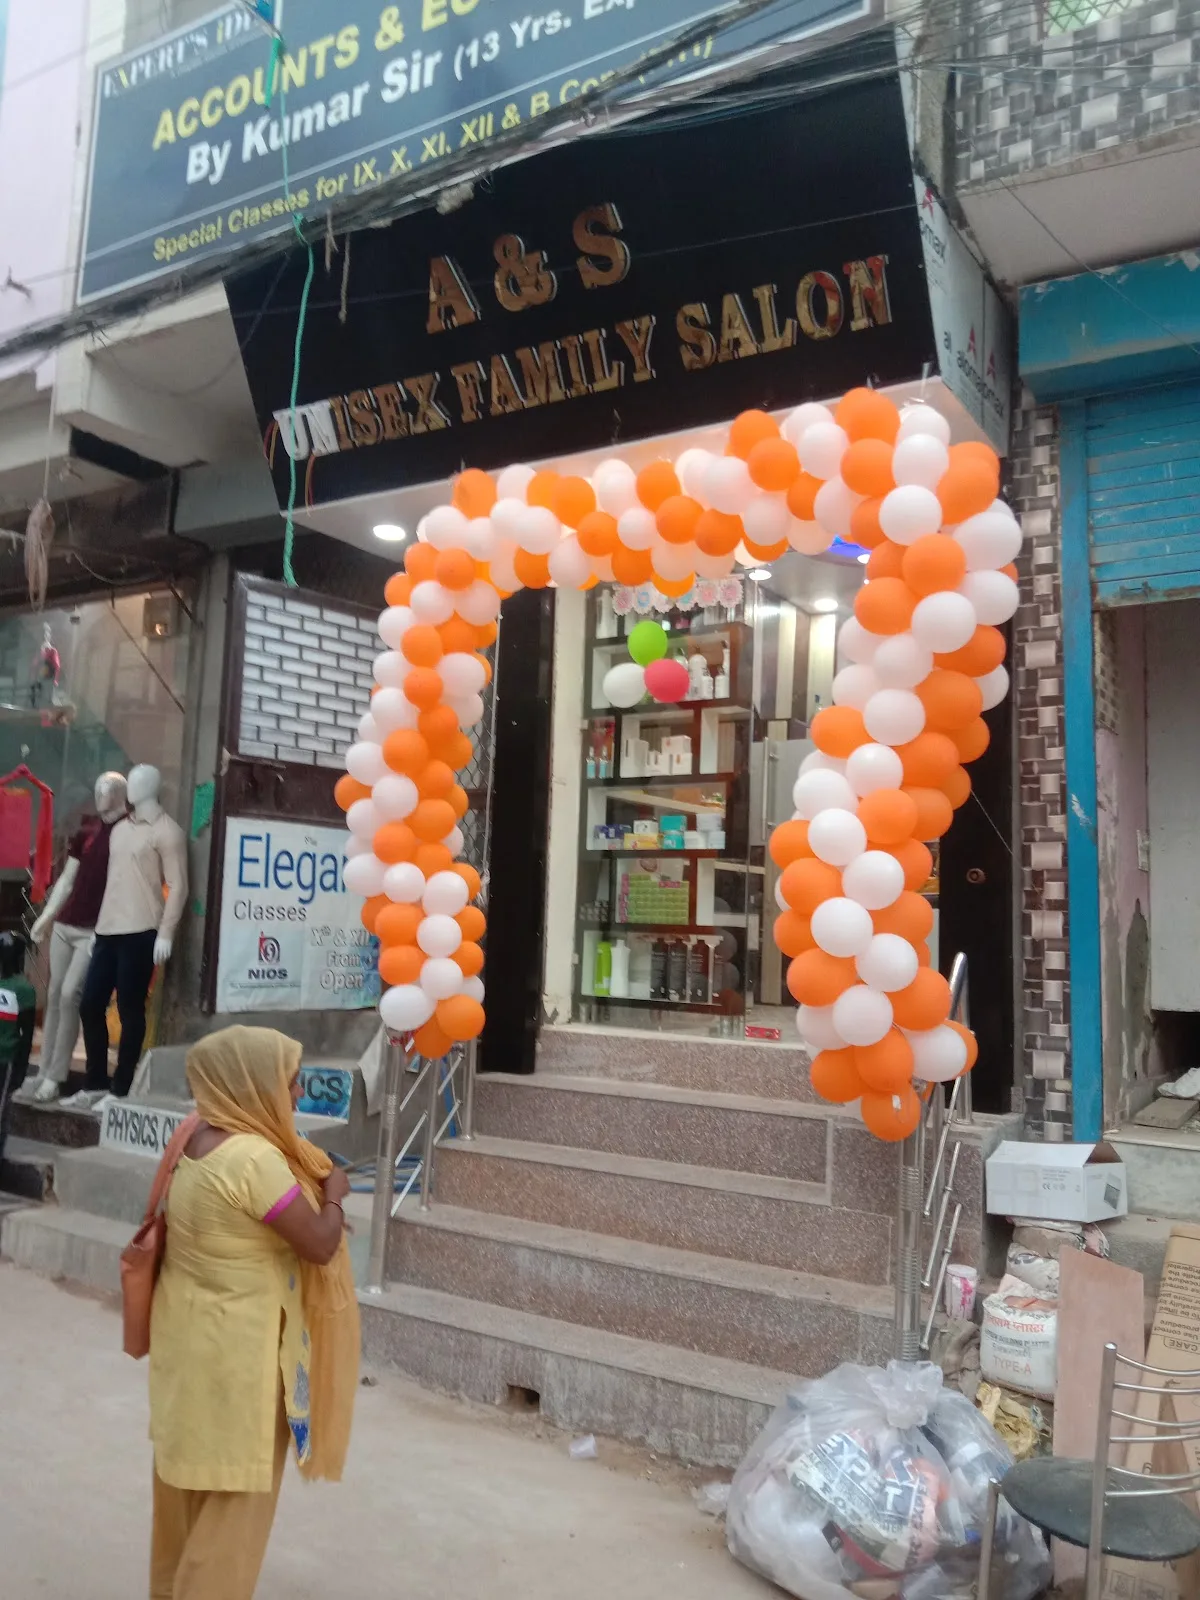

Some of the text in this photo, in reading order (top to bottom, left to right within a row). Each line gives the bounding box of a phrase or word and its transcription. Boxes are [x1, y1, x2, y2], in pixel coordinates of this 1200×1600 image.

[153, 24, 360, 150] ACCOUNTS
[374, 6, 405, 51] &
[186, 141, 232, 185] By
[242, 81, 371, 163] Kumar
[381, 49, 443, 103] Sir
[453, 30, 500, 81] (13
[509, 10, 572, 48] Yrs.
[152, 216, 223, 261] Special
[228, 189, 310, 234] Classes
[315, 172, 348, 201] for
[459, 111, 494, 148] XII
[501, 103, 521, 130] &
[427, 202, 632, 333] A & S
[272, 253, 893, 462] UNISEX FAMILY SALON
[234, 899, 307, 922] Classes
[326, 950, 362, 968] From
[248, 969, 288, 981] NIOS
[320, 969, 365, 994] Open
[107, 1108, 158, 1152] PHYSICS,
[1153, 1326, 1181, 1336] correct
[1159, 1319, 1200, 1332] procedure
[1169, 1339, 1198, 1352] CARE
[992, 1355, 1033, 1375] TYPE-A
